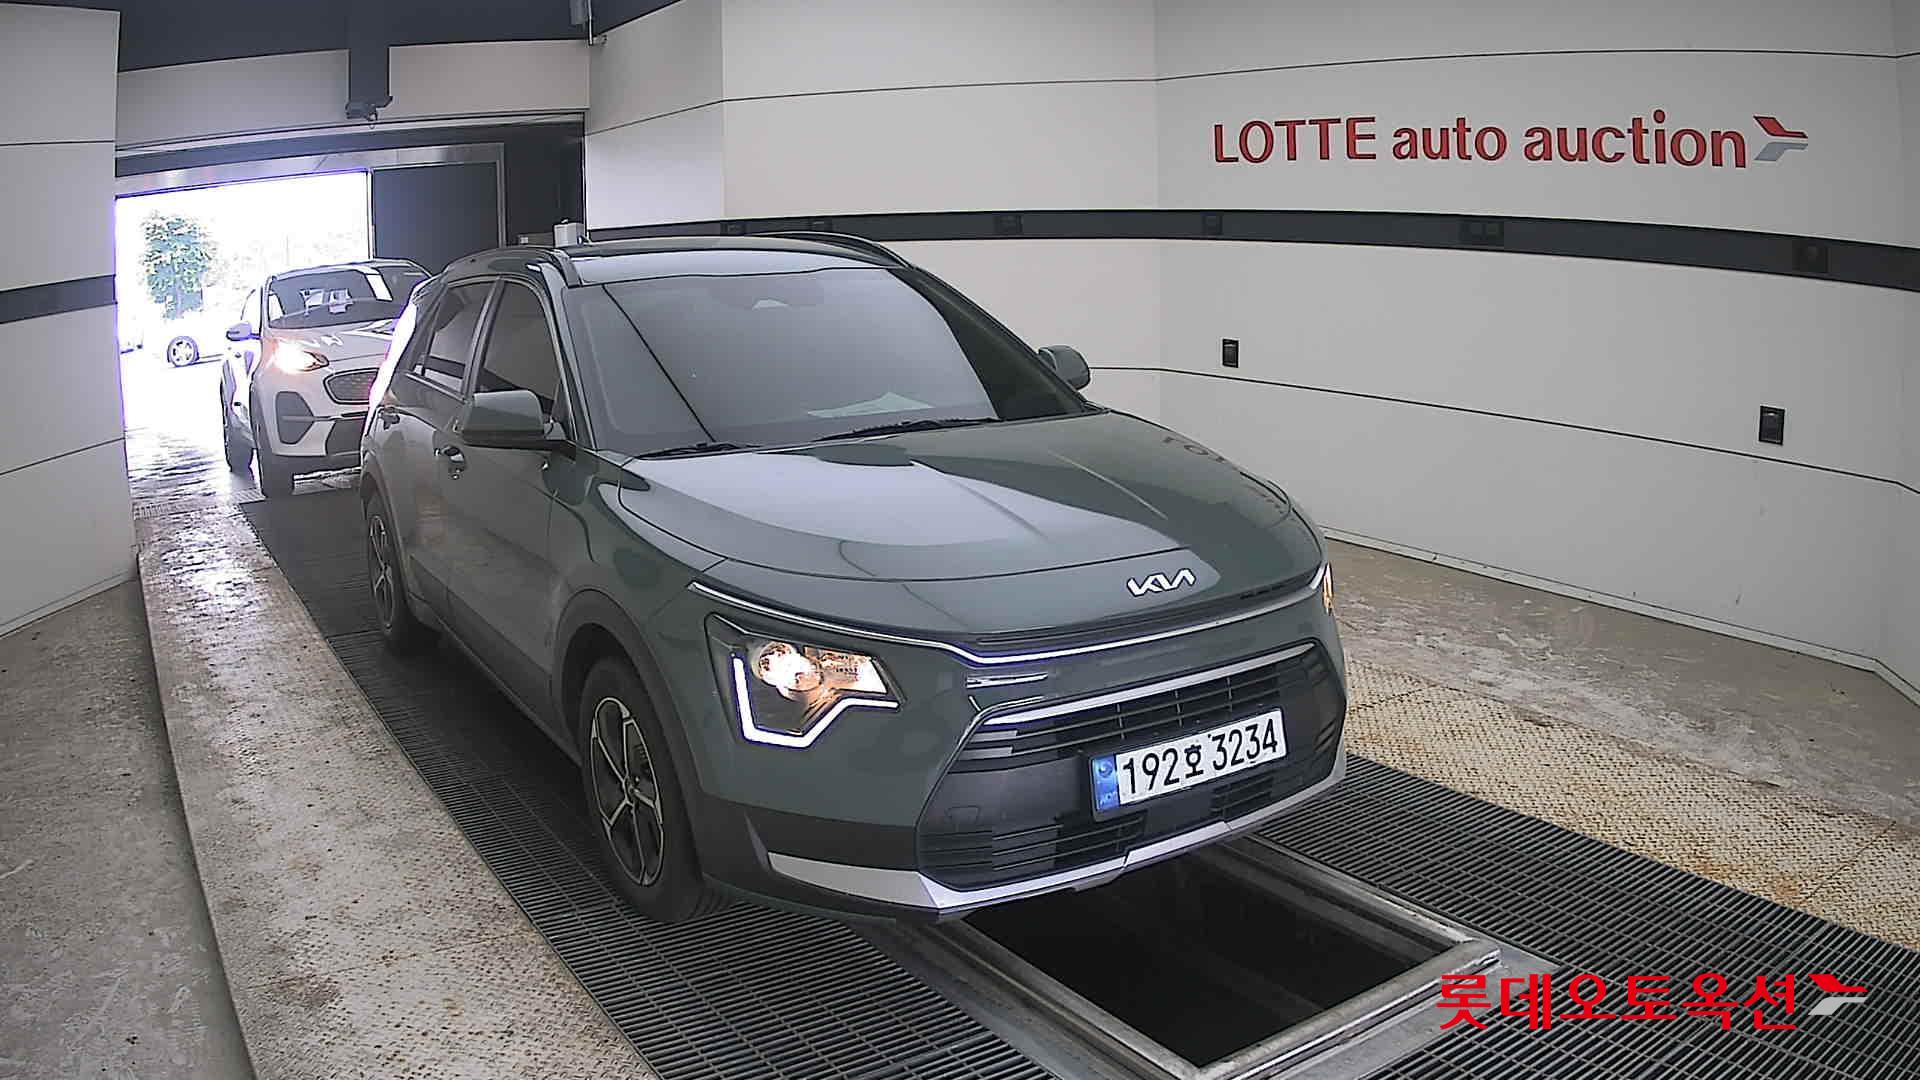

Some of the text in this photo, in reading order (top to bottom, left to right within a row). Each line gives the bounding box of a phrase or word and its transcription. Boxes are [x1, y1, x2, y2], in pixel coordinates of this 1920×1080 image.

[1214, 109, 1747, 168] LOTTE auto auction
[1127, 568, 1196, 597] KIA
[1122, 718, 1278, 794] 192호 3234
